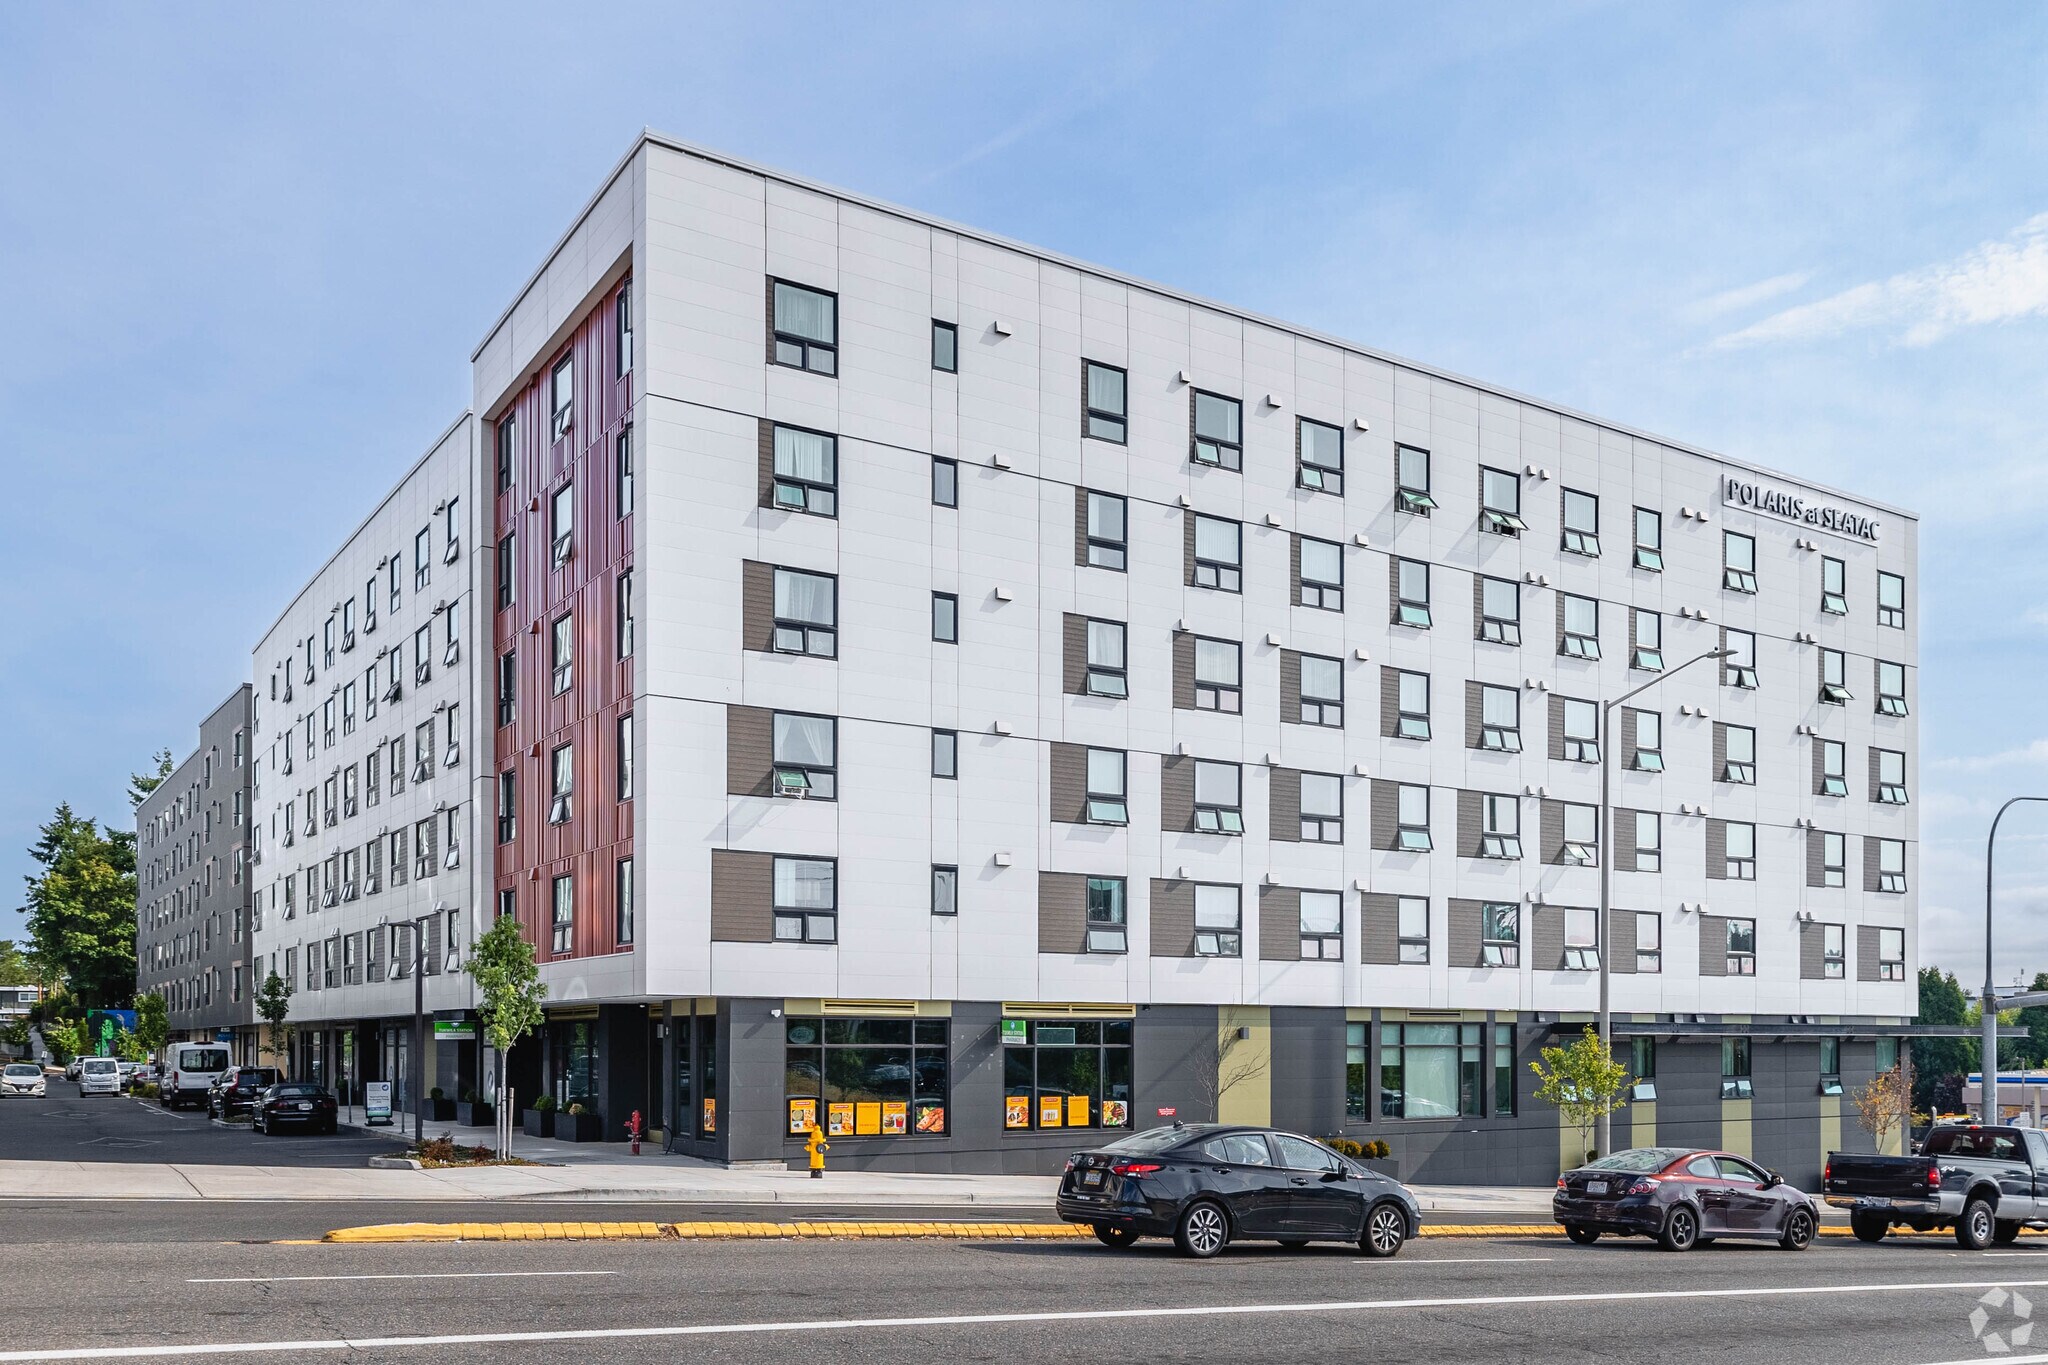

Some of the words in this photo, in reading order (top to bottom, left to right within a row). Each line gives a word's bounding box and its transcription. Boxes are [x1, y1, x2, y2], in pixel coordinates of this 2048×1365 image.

[1728, 478, 1804, 520] POLARIS
[1805, 507, 1818, 525] at
[1821, 506, 1881, 541] SEATAC
